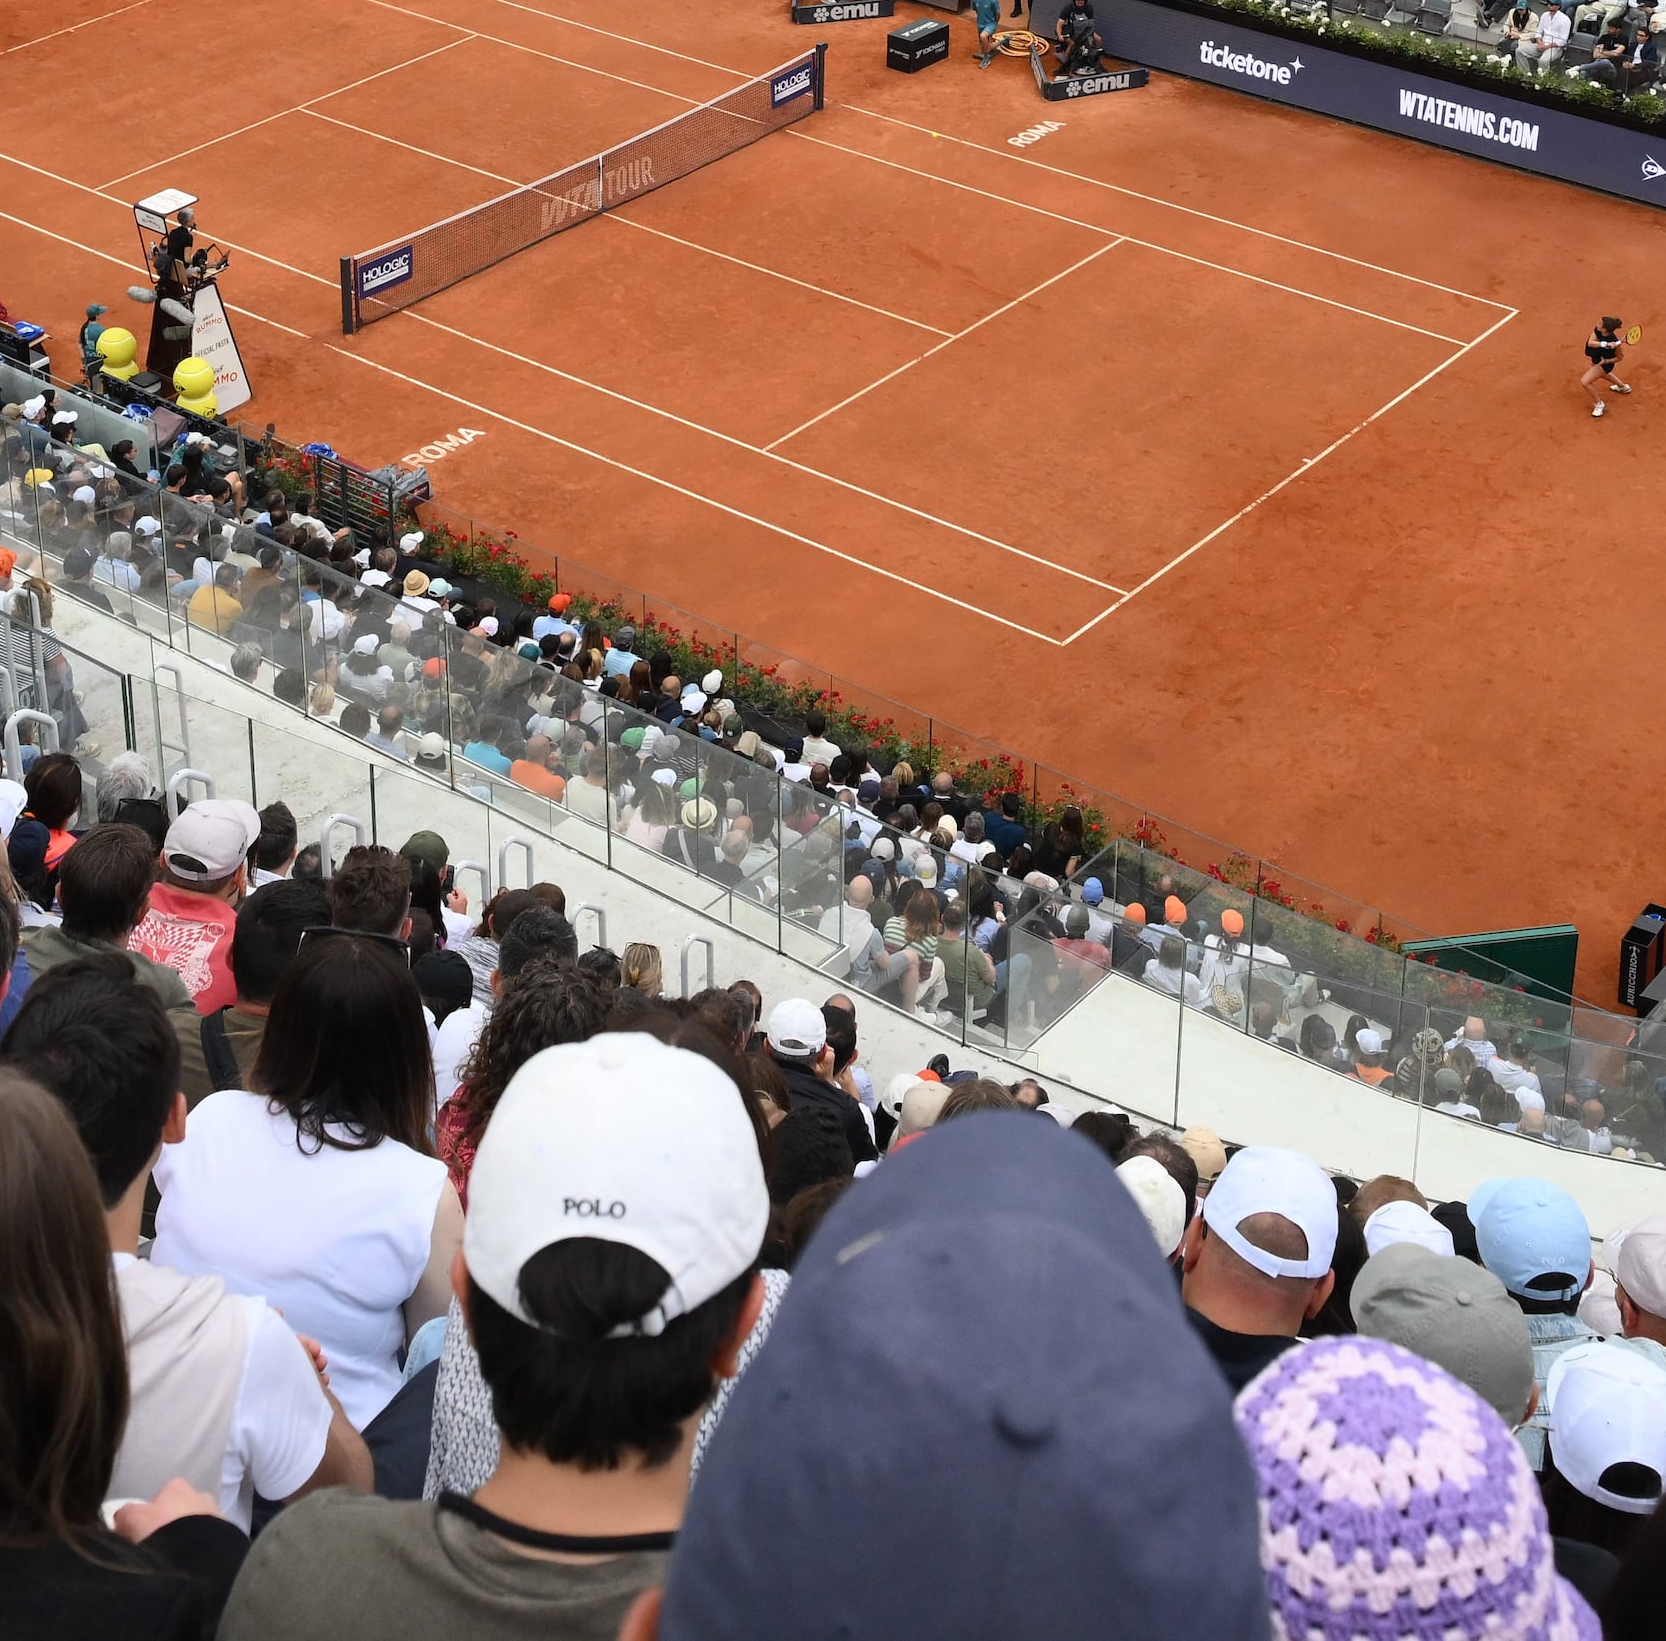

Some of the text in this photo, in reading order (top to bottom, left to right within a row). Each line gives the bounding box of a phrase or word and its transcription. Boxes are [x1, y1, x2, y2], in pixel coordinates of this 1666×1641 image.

[830, 2, 879, 18] emu
[1199, 39, 1292, 85] ticketone
[774, 68, 810, 95] HOLOGIC
[1082, 73, 1131, 94] emu
[1399, 88, 1540, 151] WTATENNIS.COM
[1006, 118, 1067, 149] ROMA
[605, 156, 656, 200] TOUR
[362, 254, 409, 284] HOLOGIC
[196, 317, 223, 334] RUMMO
[215, 337, 230, 352] PASTA
[213, 372, 238, 387] MMO
[401, 427, 487, 468] ROMA
[1627, 958, 1638, 1006] AURICCHIO
[563, 1198, 626, 1219] POLO
[1541, 1256, 1565, 1265] POLO
